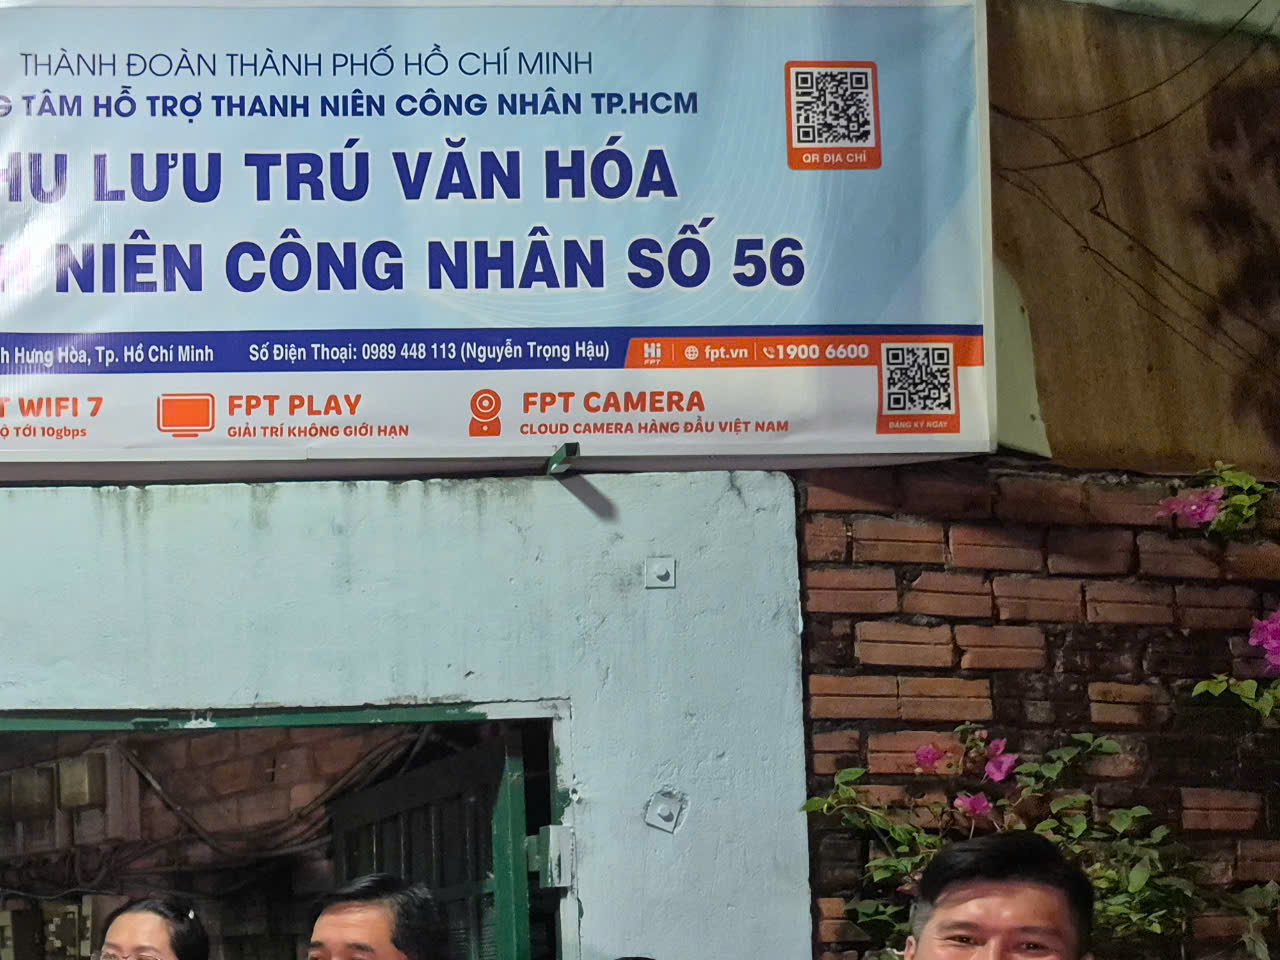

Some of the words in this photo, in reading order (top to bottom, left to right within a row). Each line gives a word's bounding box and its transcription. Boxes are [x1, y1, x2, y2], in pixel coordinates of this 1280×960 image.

[21, 48, 116, 76] THÀNH
[127, 48, 216, 76] ĐOÀN
[226, 47, 321, 76] THÀNH
[333, 45, 394, 76] PHỐ
[405, 44, 448, 76] HỒ
[459, 47, 507, 75] CHÍ
[519, 52, 592, 74] MINH
[22, 89, 82, 116] TÂM
[94, 86, 136, 117] HỖ
[146, 91, 201, 123] TRỢ
[211, 95, 309, 117] THANH
[321, 89, 384, 117] NIÊN
[396, 88, 487, 117] CÔNG
[498, 87, 581, 115] NHÂN
[592, 92, 697, 115] TP.HCM
[94, 153, 220, 203] LƯU
[244, 138, 369, 202] TRÚ
[392, 137, 520, 200] VĂN
[545, 136, 678, 200] HÓA
[802, 153, 820, 163] QR
[823, 153, 842, 165] ĐỊA
[55, 229, 203, 293] NIÊN
[225, 228, 404, 293] CÔNG
[428, 226, 604, 290] NHÂN
[627, 217, 715, 289] SỐ
[732, 238, 805, 288] 56
[15, 347, 54, 367] Hưng
[58, 346, 91, 366] Hòa,
[95, 346, 119, 366] Tp.
[124, 342, 144, 363] Hồ
[149, 344, 173, 363] Chí
[178, 344, 214, 362] Minh
[249, 341, 269, 361] Số
[273, 343, 306, 364] Điện
[311, 343, 357, 364] Thoại:
[362, 343, 396, 360] 0989
[401, 343, 426, 360] 448
[431, 342, 456, 359] 113
[460, 339, 522, 362] (Nguyễn
[527, 341, 570, 361] Trọng
[575, 340, 609, 361] Hậu)
[643, 343, 662, 358] Hi
[705, 346, 748, 362] fpt.vn
[777, 345, 819, 360] 1900
[825, 344, 869, 359] 6600
[19, 397, 79, 418] WIFI
[87, 397, 104, 417] 7
[228, 395, 280, 416] FPT
[289, 394, 362, 416] PLAY
[523, 392, 575, 413] FPT
[583, 391, 705, 413] CAMERA
[13, 424, 36, 437] TỚI
[41, 426, 87, 440] 10gbps
[228, 423, 256, 438] GIẢI
[261, 423, 284, 438] TRÍ
[288, 423, 339, 437] KHÔNG
[343, 423, 373, 436] GIỚI
[378, 424, 409, 439] HẠN
[520, 423, 569, 435] CLOUD
[573, 422, 633, 434] CAMERA
[638, 419, 680, 433] HÀNG
[683, 416, 716, 433] ĐẦU
[719, 418, 752, 434] VIỆT
[755, 421, 789, 433] NAM
